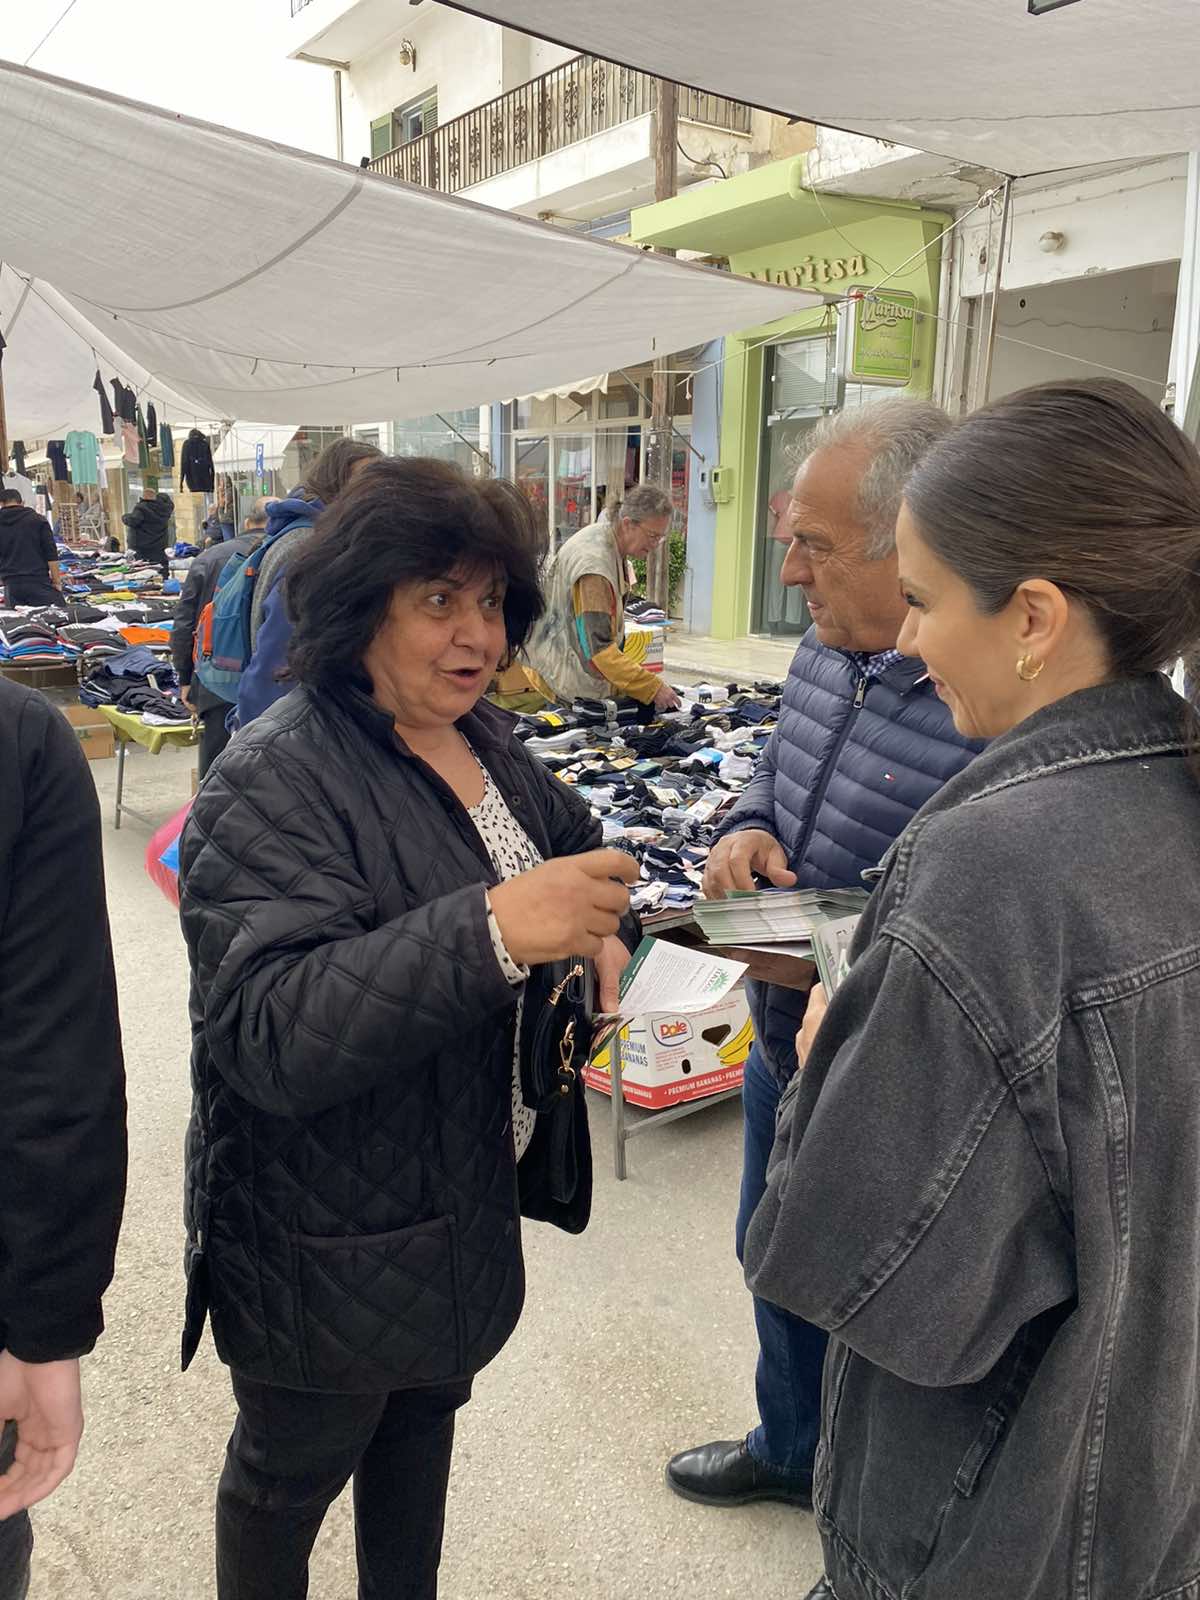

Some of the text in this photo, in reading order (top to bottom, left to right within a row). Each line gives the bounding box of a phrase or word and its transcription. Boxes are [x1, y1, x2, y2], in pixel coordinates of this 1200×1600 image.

[659, 1020, 688, 1037] Dole
[668, 1082, 696, 1096] PREMIUM
[696, 1074, 722, 1089] BANANAS
